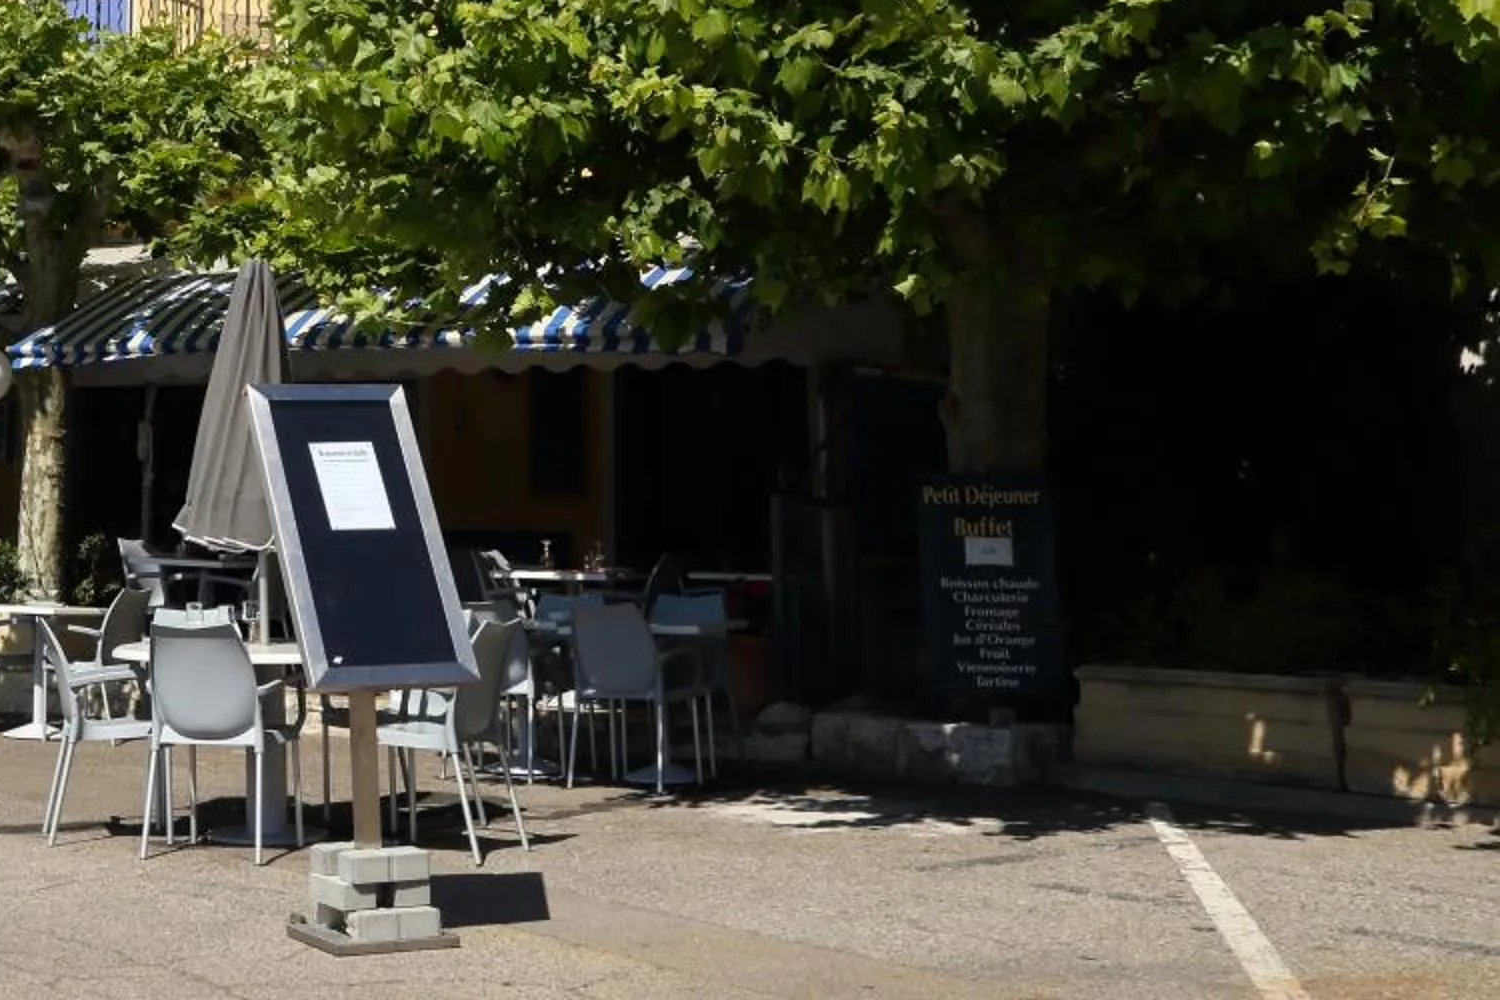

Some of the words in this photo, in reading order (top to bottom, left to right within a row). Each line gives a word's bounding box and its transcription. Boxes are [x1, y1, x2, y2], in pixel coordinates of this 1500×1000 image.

[921, 484, 960, 505] Petit
[964, 483, 1041, 508] Déjeuner
[954, 515, 1013, 537] Buffet
